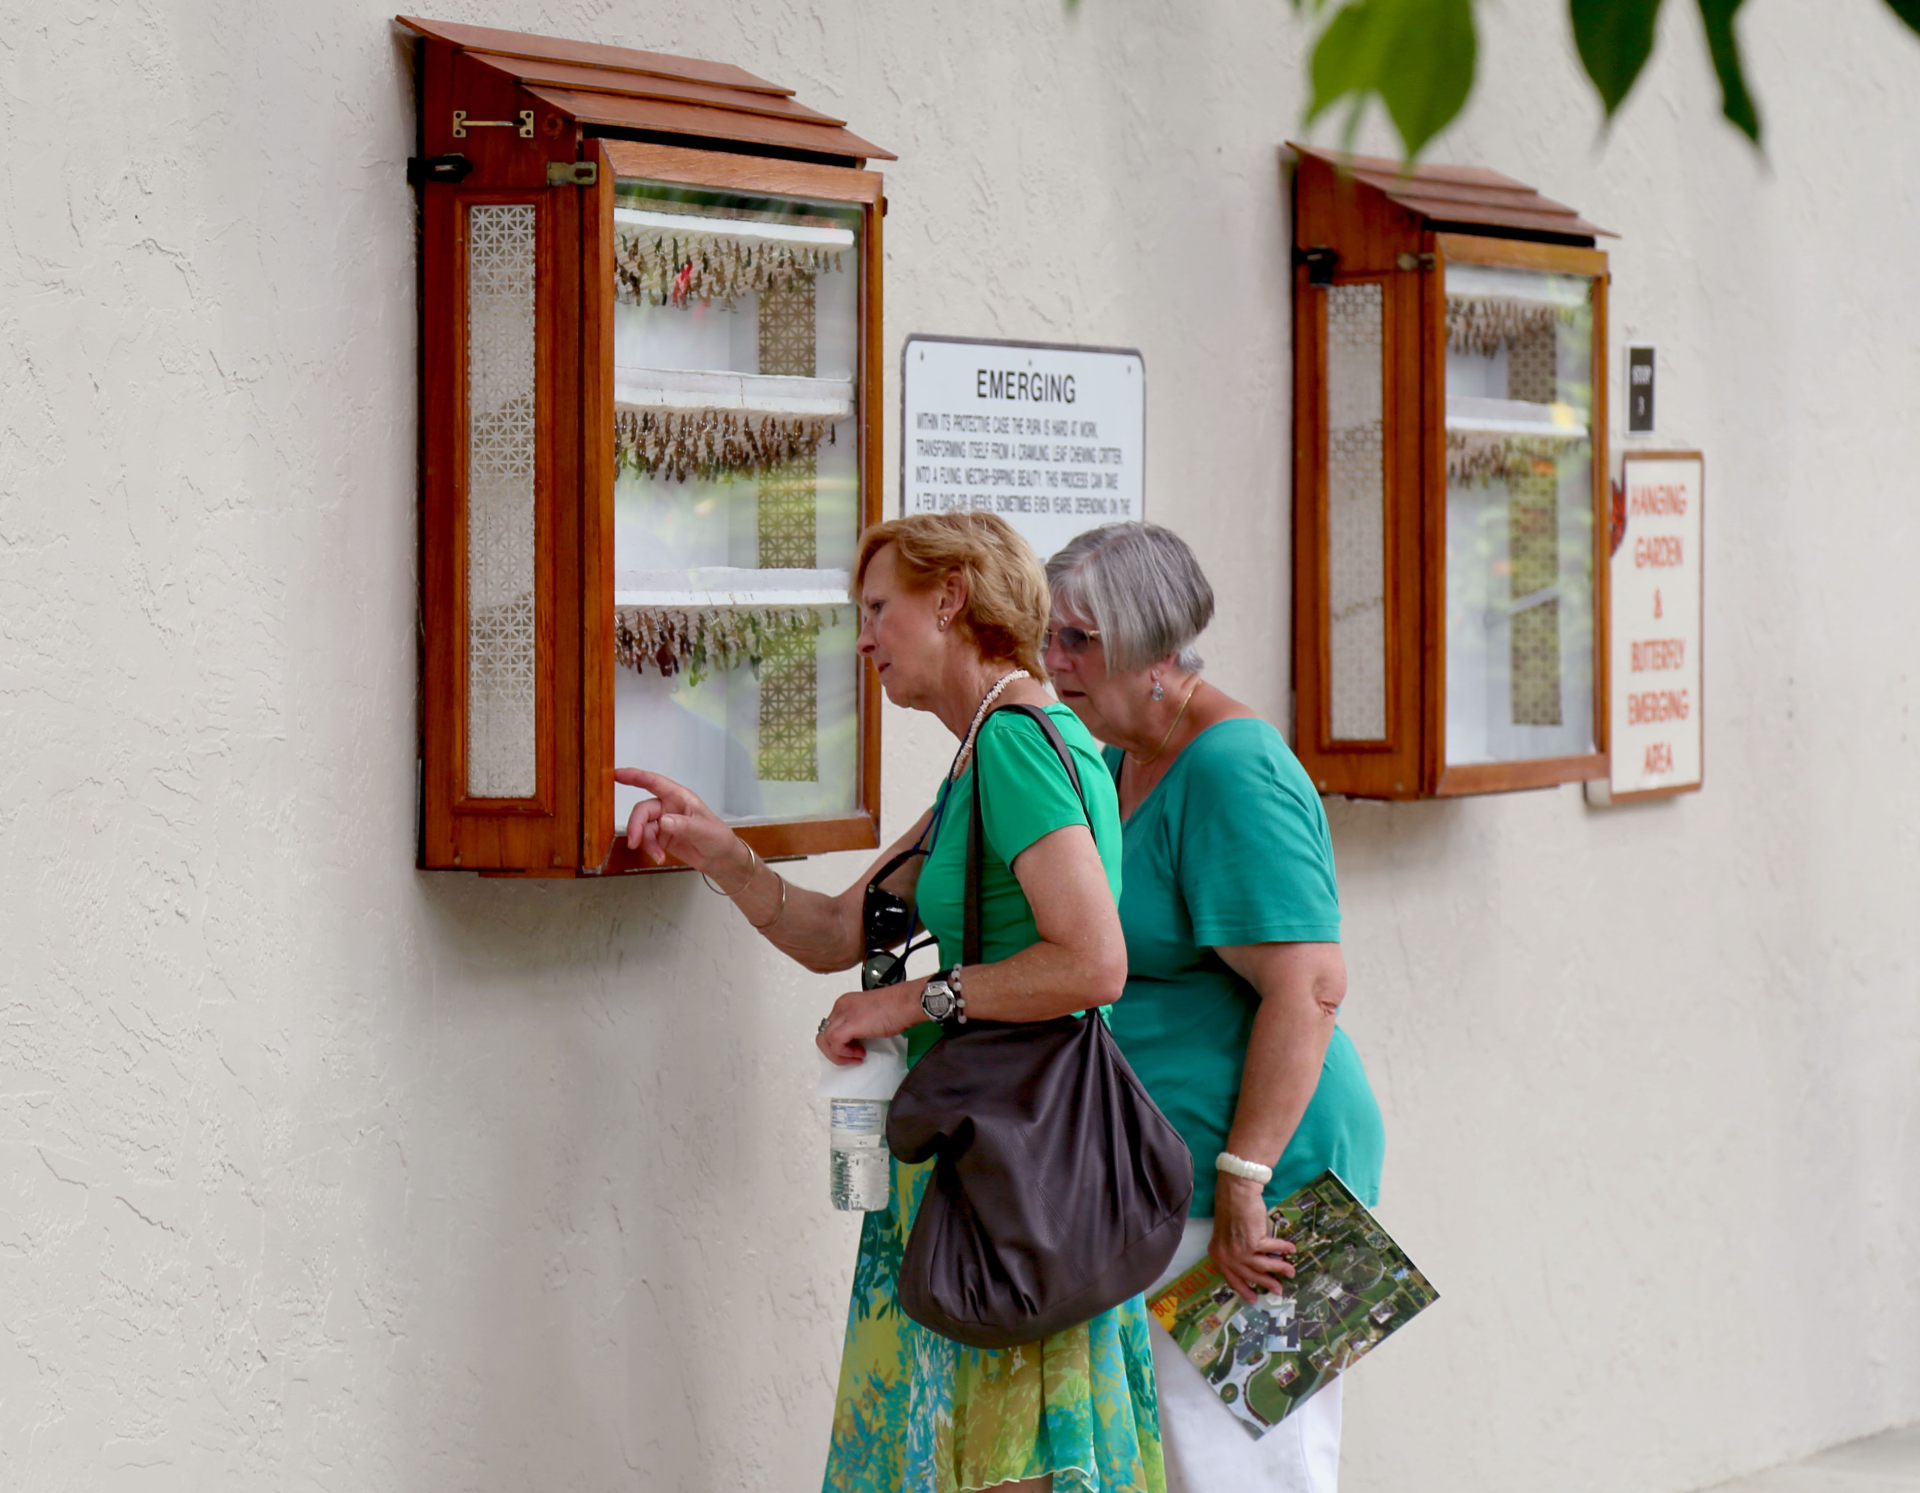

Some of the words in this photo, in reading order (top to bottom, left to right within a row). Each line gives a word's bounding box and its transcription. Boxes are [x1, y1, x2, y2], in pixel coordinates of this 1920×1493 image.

[976, 368, 1076, 404] EMERGING
[953, 414, 991, 433] PROTECTIVE
[993, 416, 1009, 434] CASE
[1012, 417, 1024, 435] THE
[1043, 419, 1050, 436] IS
[1052, 420, 1069, 437] HARD
[1071, 420, 1078, 437] AT
[916, 439, 966, 458] TRANSFORMING
[969, 441, 989, 459] ITSELF
[991, 442, 1009, 460] FROM
[1011, 443, 1016, 460] A
[915, 466, 931, 483] INTO
[933, 467, 938, 483] A
[1061, 470, 1089, 489] PROCESS
[1120, 498, 1132, 516] THE
[1630, 483, 1688, 517] HANGING
[1635, 535, 1685, 569] GARDEN
[1653, 587, 1664, 620] &
[1630, 638, 1687, 673] BUTTERFLY
[1628, 687, 1690, 726] EMERGING
[1642, 742, 1675, 777] AREA
[1149, 1270, 1210, 1318] BUTTERFLY
